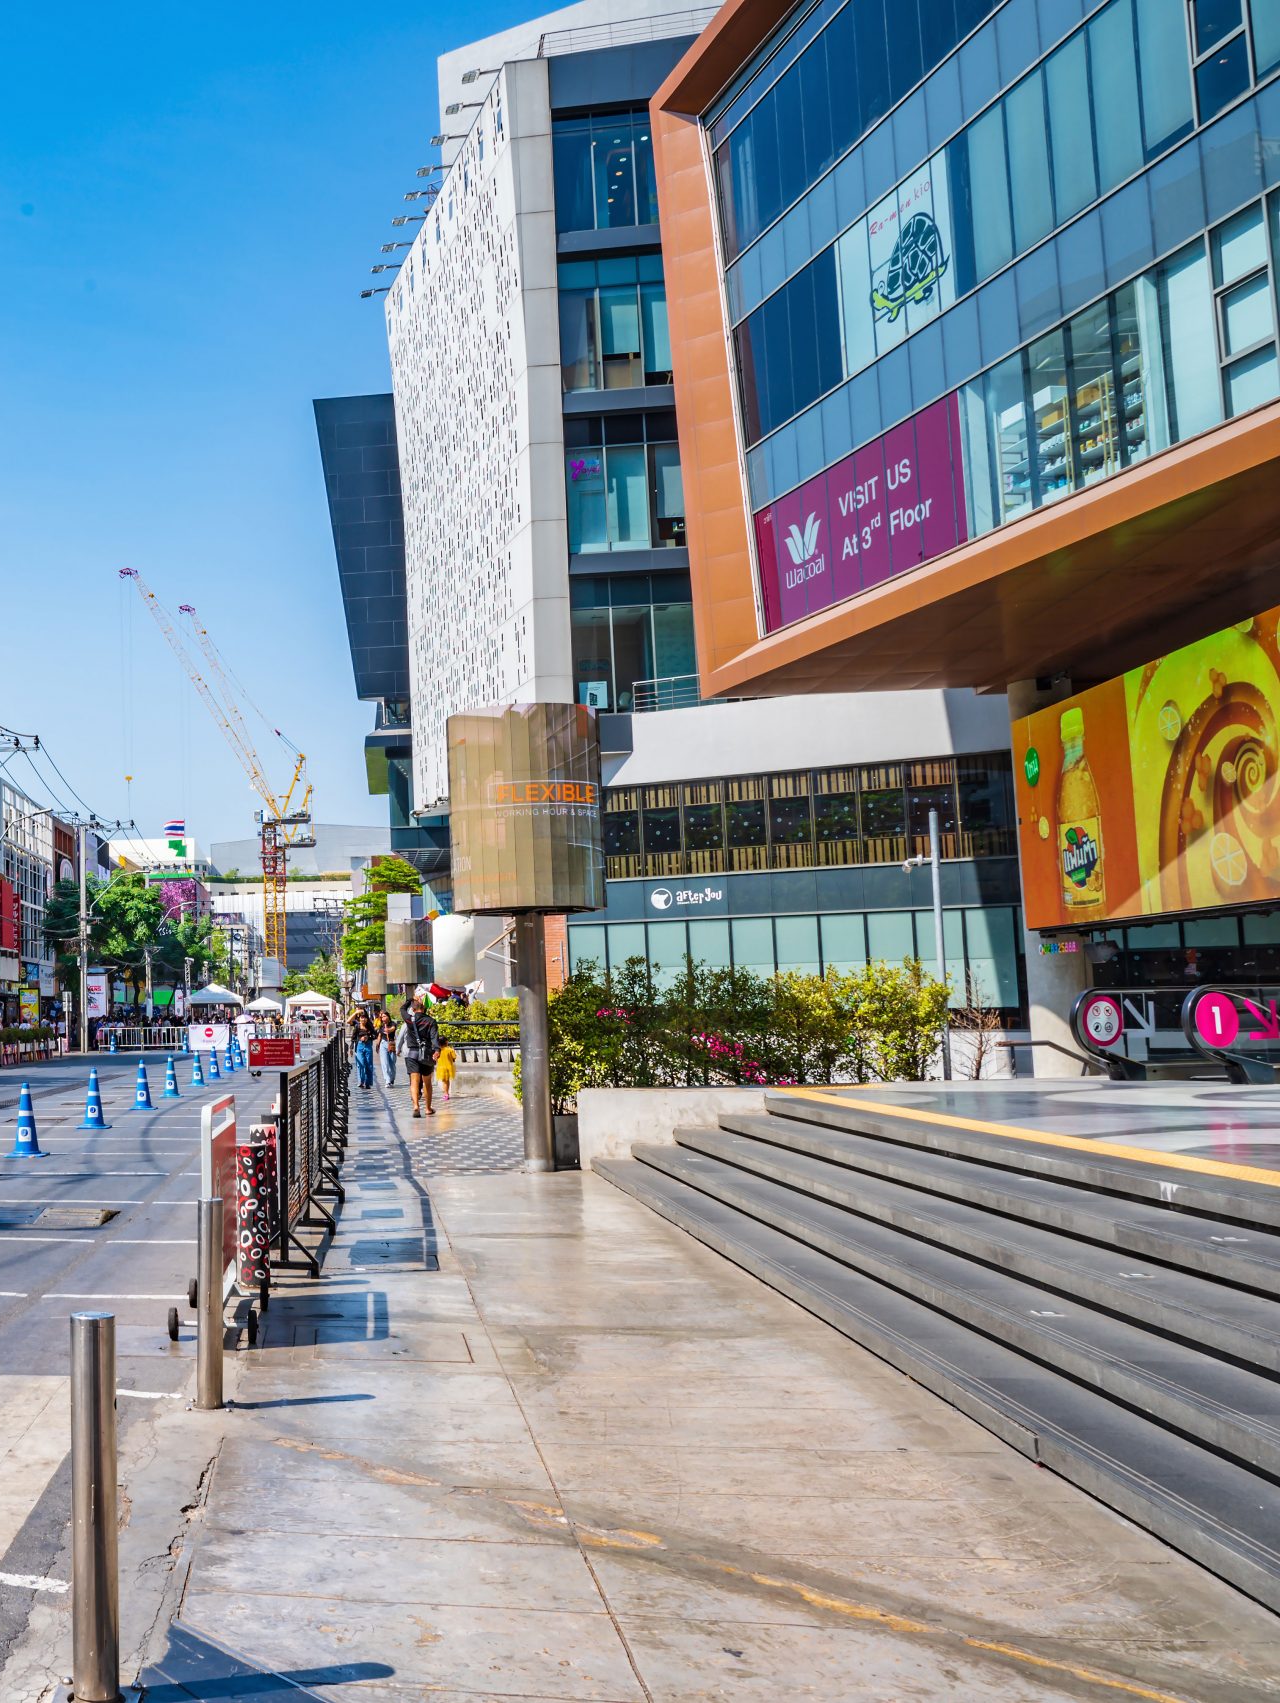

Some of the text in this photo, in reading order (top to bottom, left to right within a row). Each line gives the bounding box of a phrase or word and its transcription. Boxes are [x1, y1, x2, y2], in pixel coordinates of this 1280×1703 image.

[838, 458, 912, 518] VISIT US
[841, 534, 859, 561] At
[889, 498, 933, 536] Floor
[496, 783, 595, 804] FLEXIBLE
[495, 807, 597, 818] WORKING HOUR & SPACE
[1212, 1006, 1222, 1035] 1
